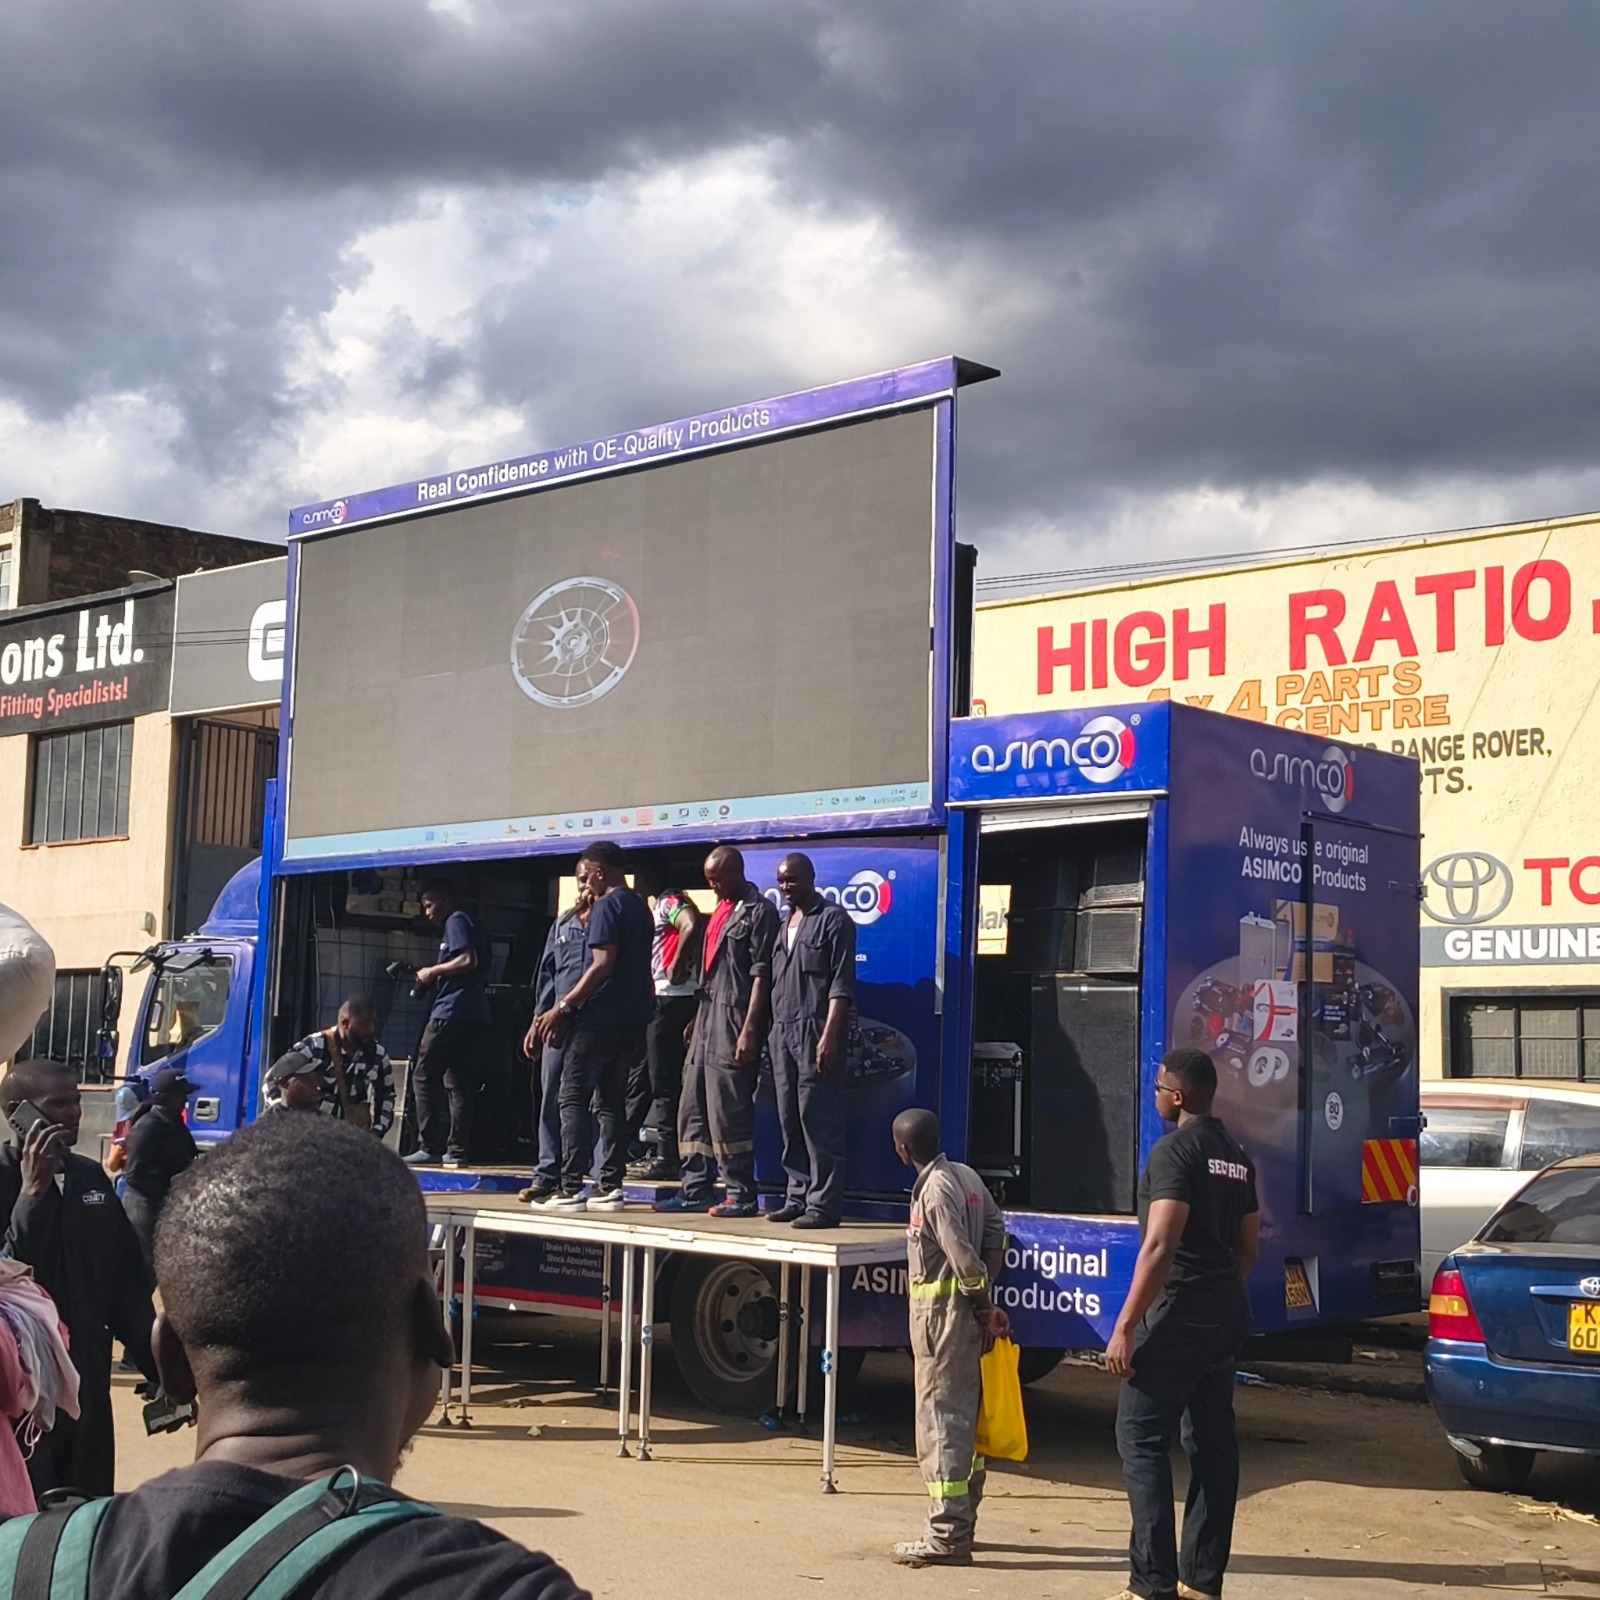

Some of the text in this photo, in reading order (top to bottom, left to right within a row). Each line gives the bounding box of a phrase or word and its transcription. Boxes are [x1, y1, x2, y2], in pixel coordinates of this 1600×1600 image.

[418, 407, 770, 501] Real Confidence with OE-Quality Products
[1, 599, 144, 684] ons Ltd.
[1037, 559, 1571, 694] HIGH RATIO
[0, 676, 128, 719] Fitting Specialists!
[1276, 661, 1422, 706] PARTS
[1276, 694, 1450, 736] CENTRE
[972, 716, 1137, 783] asimco
[1391, 727, 1552, 764] RANGE ROVER,
[1239, 826, 1288, 857] Always
[1326, 840, 1369, 866] original
[1241, 856, 1366, 891] ASIMCO Products
[1329, 1101, 1340, 1115] 80
[1005, 1244, 1107, 1279] original
[988, 1281, 1101, 1316] roducts
